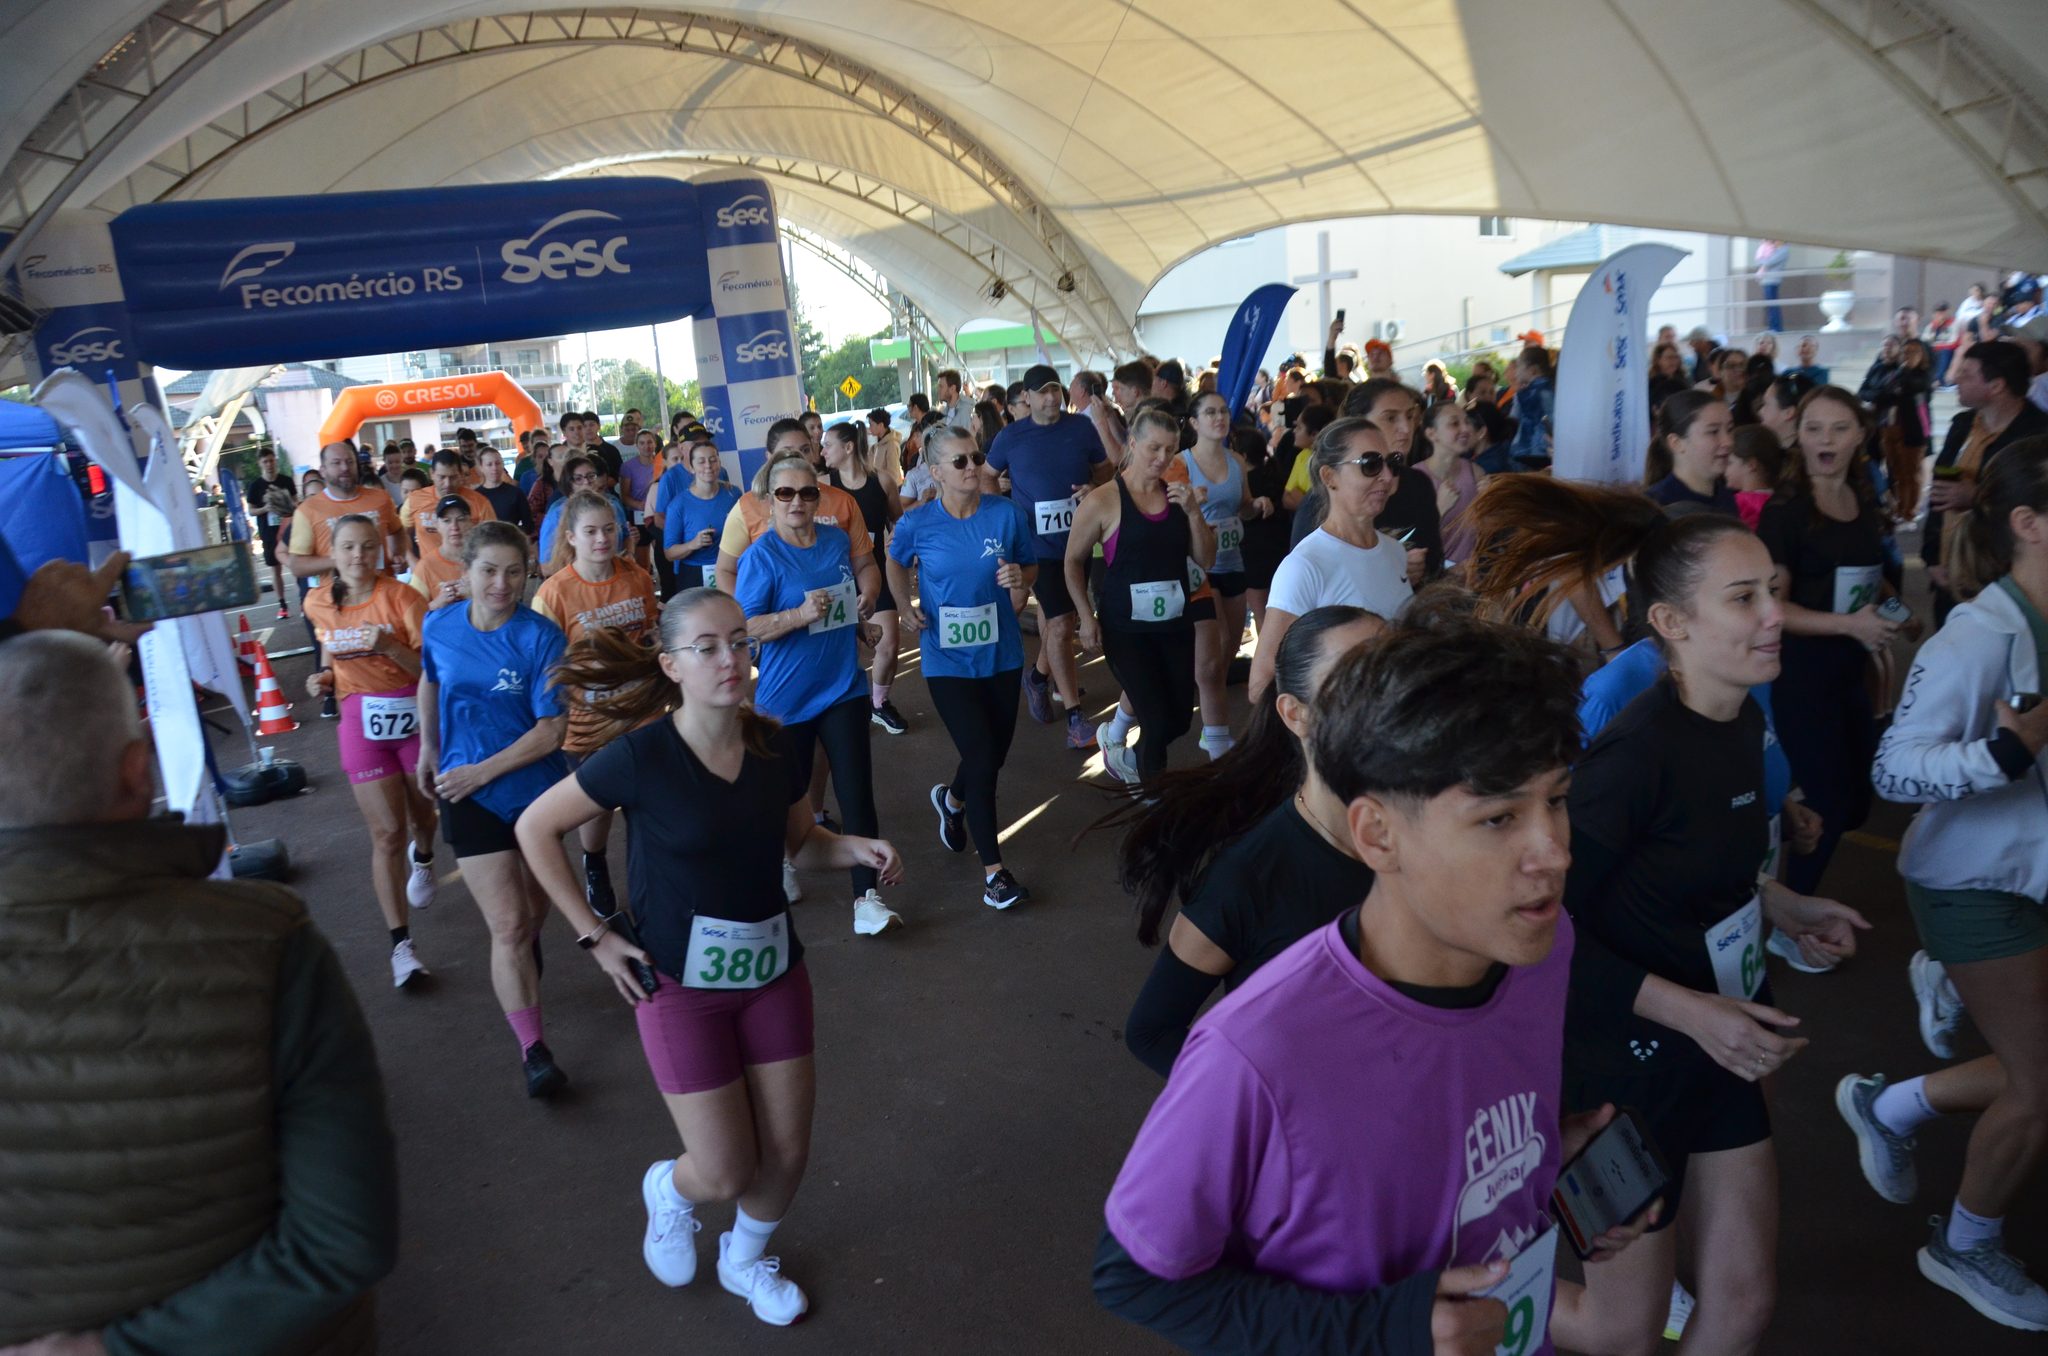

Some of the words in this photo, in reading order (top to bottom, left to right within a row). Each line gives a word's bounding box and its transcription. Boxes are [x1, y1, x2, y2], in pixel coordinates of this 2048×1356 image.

[716, 207, 769, 228] Sesc
[501, 236, 631, 284] Sesc
[241, 271, 416, 309] Fecomércio
[423, 266, 464, 293] RS
[50, 339, 125, 366] Sesc
[736, 341, 788, 363] Sesc
[403, 383, 482, 405] CRESOL
[1041, 510, 1073, 531] 710
[1153, 596, 1166, 618] 8
[948, 619, 992, 645] 300
[370, 712, 415, 737] 672
[701, 926, 728, 939] Sesc
[699, 945, 778, 983] 380
